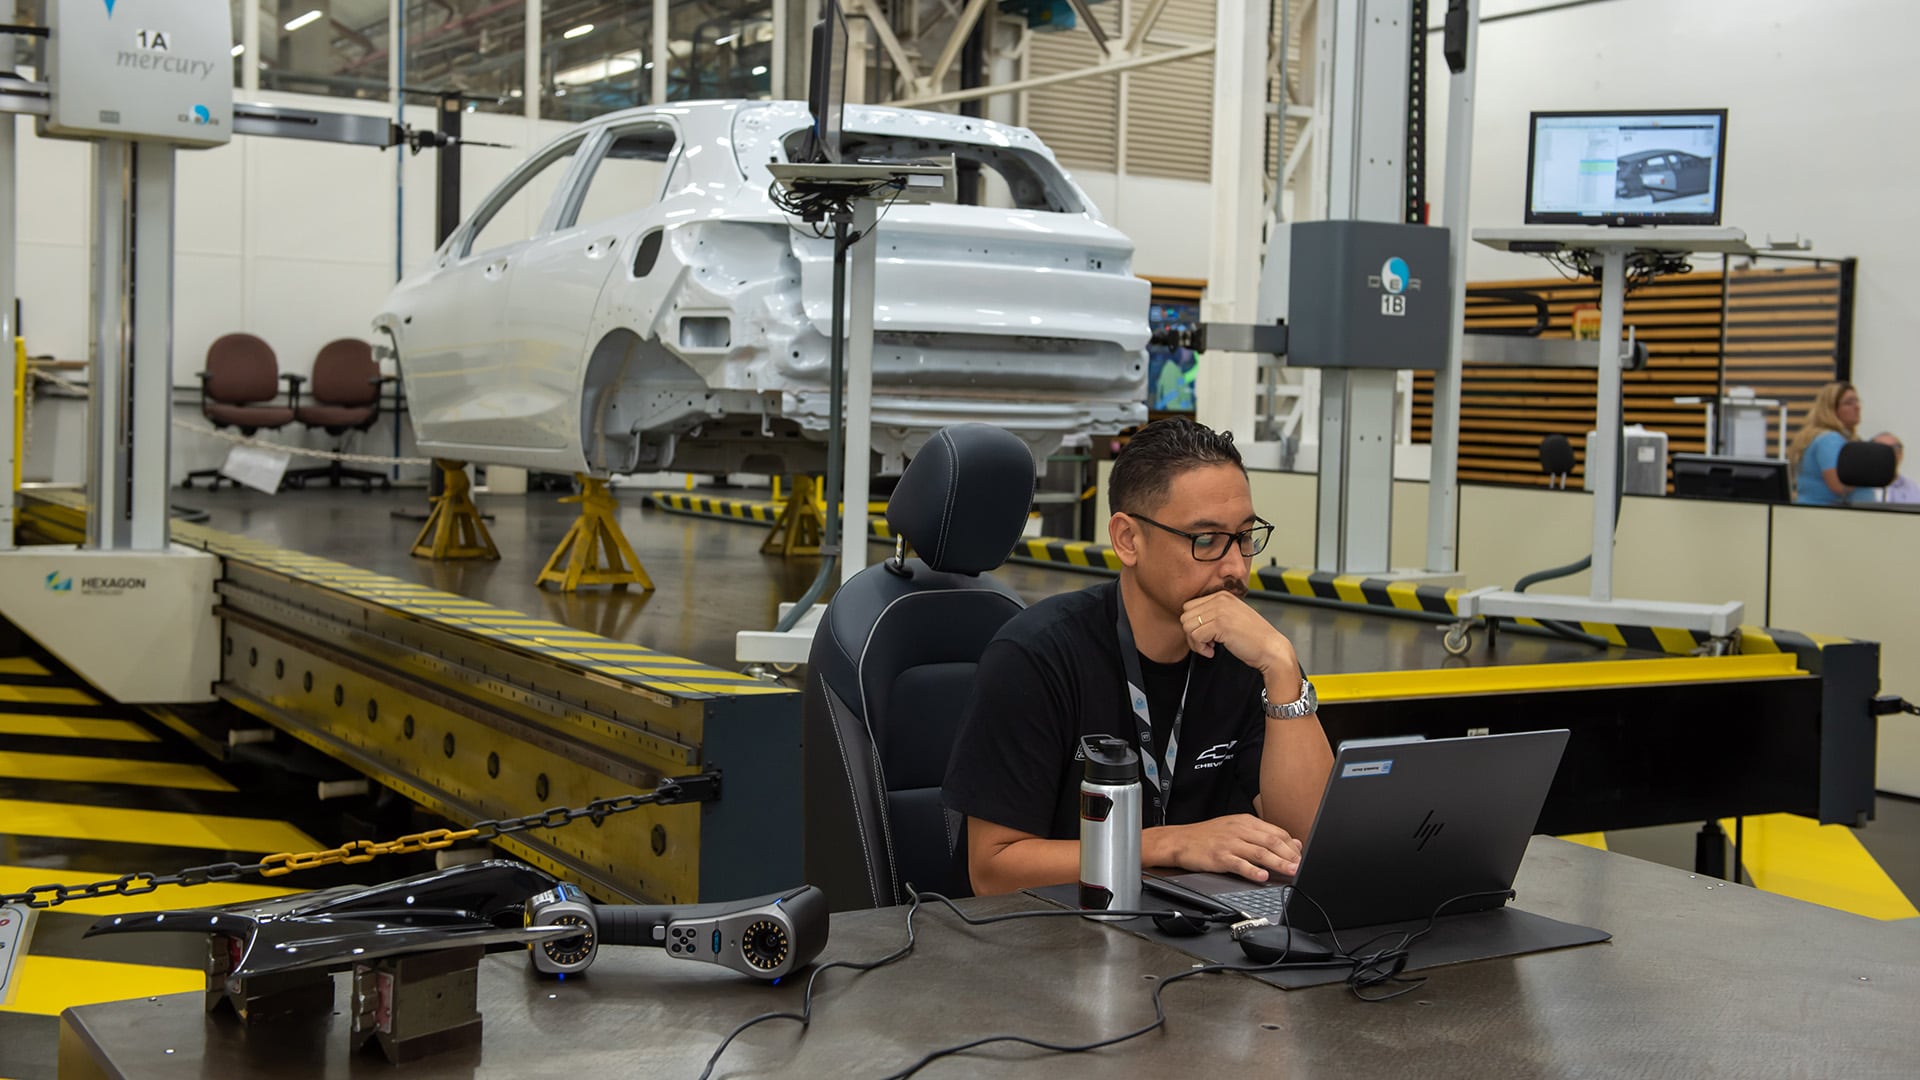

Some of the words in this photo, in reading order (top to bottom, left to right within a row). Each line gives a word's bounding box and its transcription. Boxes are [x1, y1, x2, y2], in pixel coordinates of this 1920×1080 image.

[138, 30, 168, 51] 1A
[116, 51, 215, 81] mercury
[1384, 296, 1404, 313] 1B
[81, 577, 146, 589] HEXAGON
